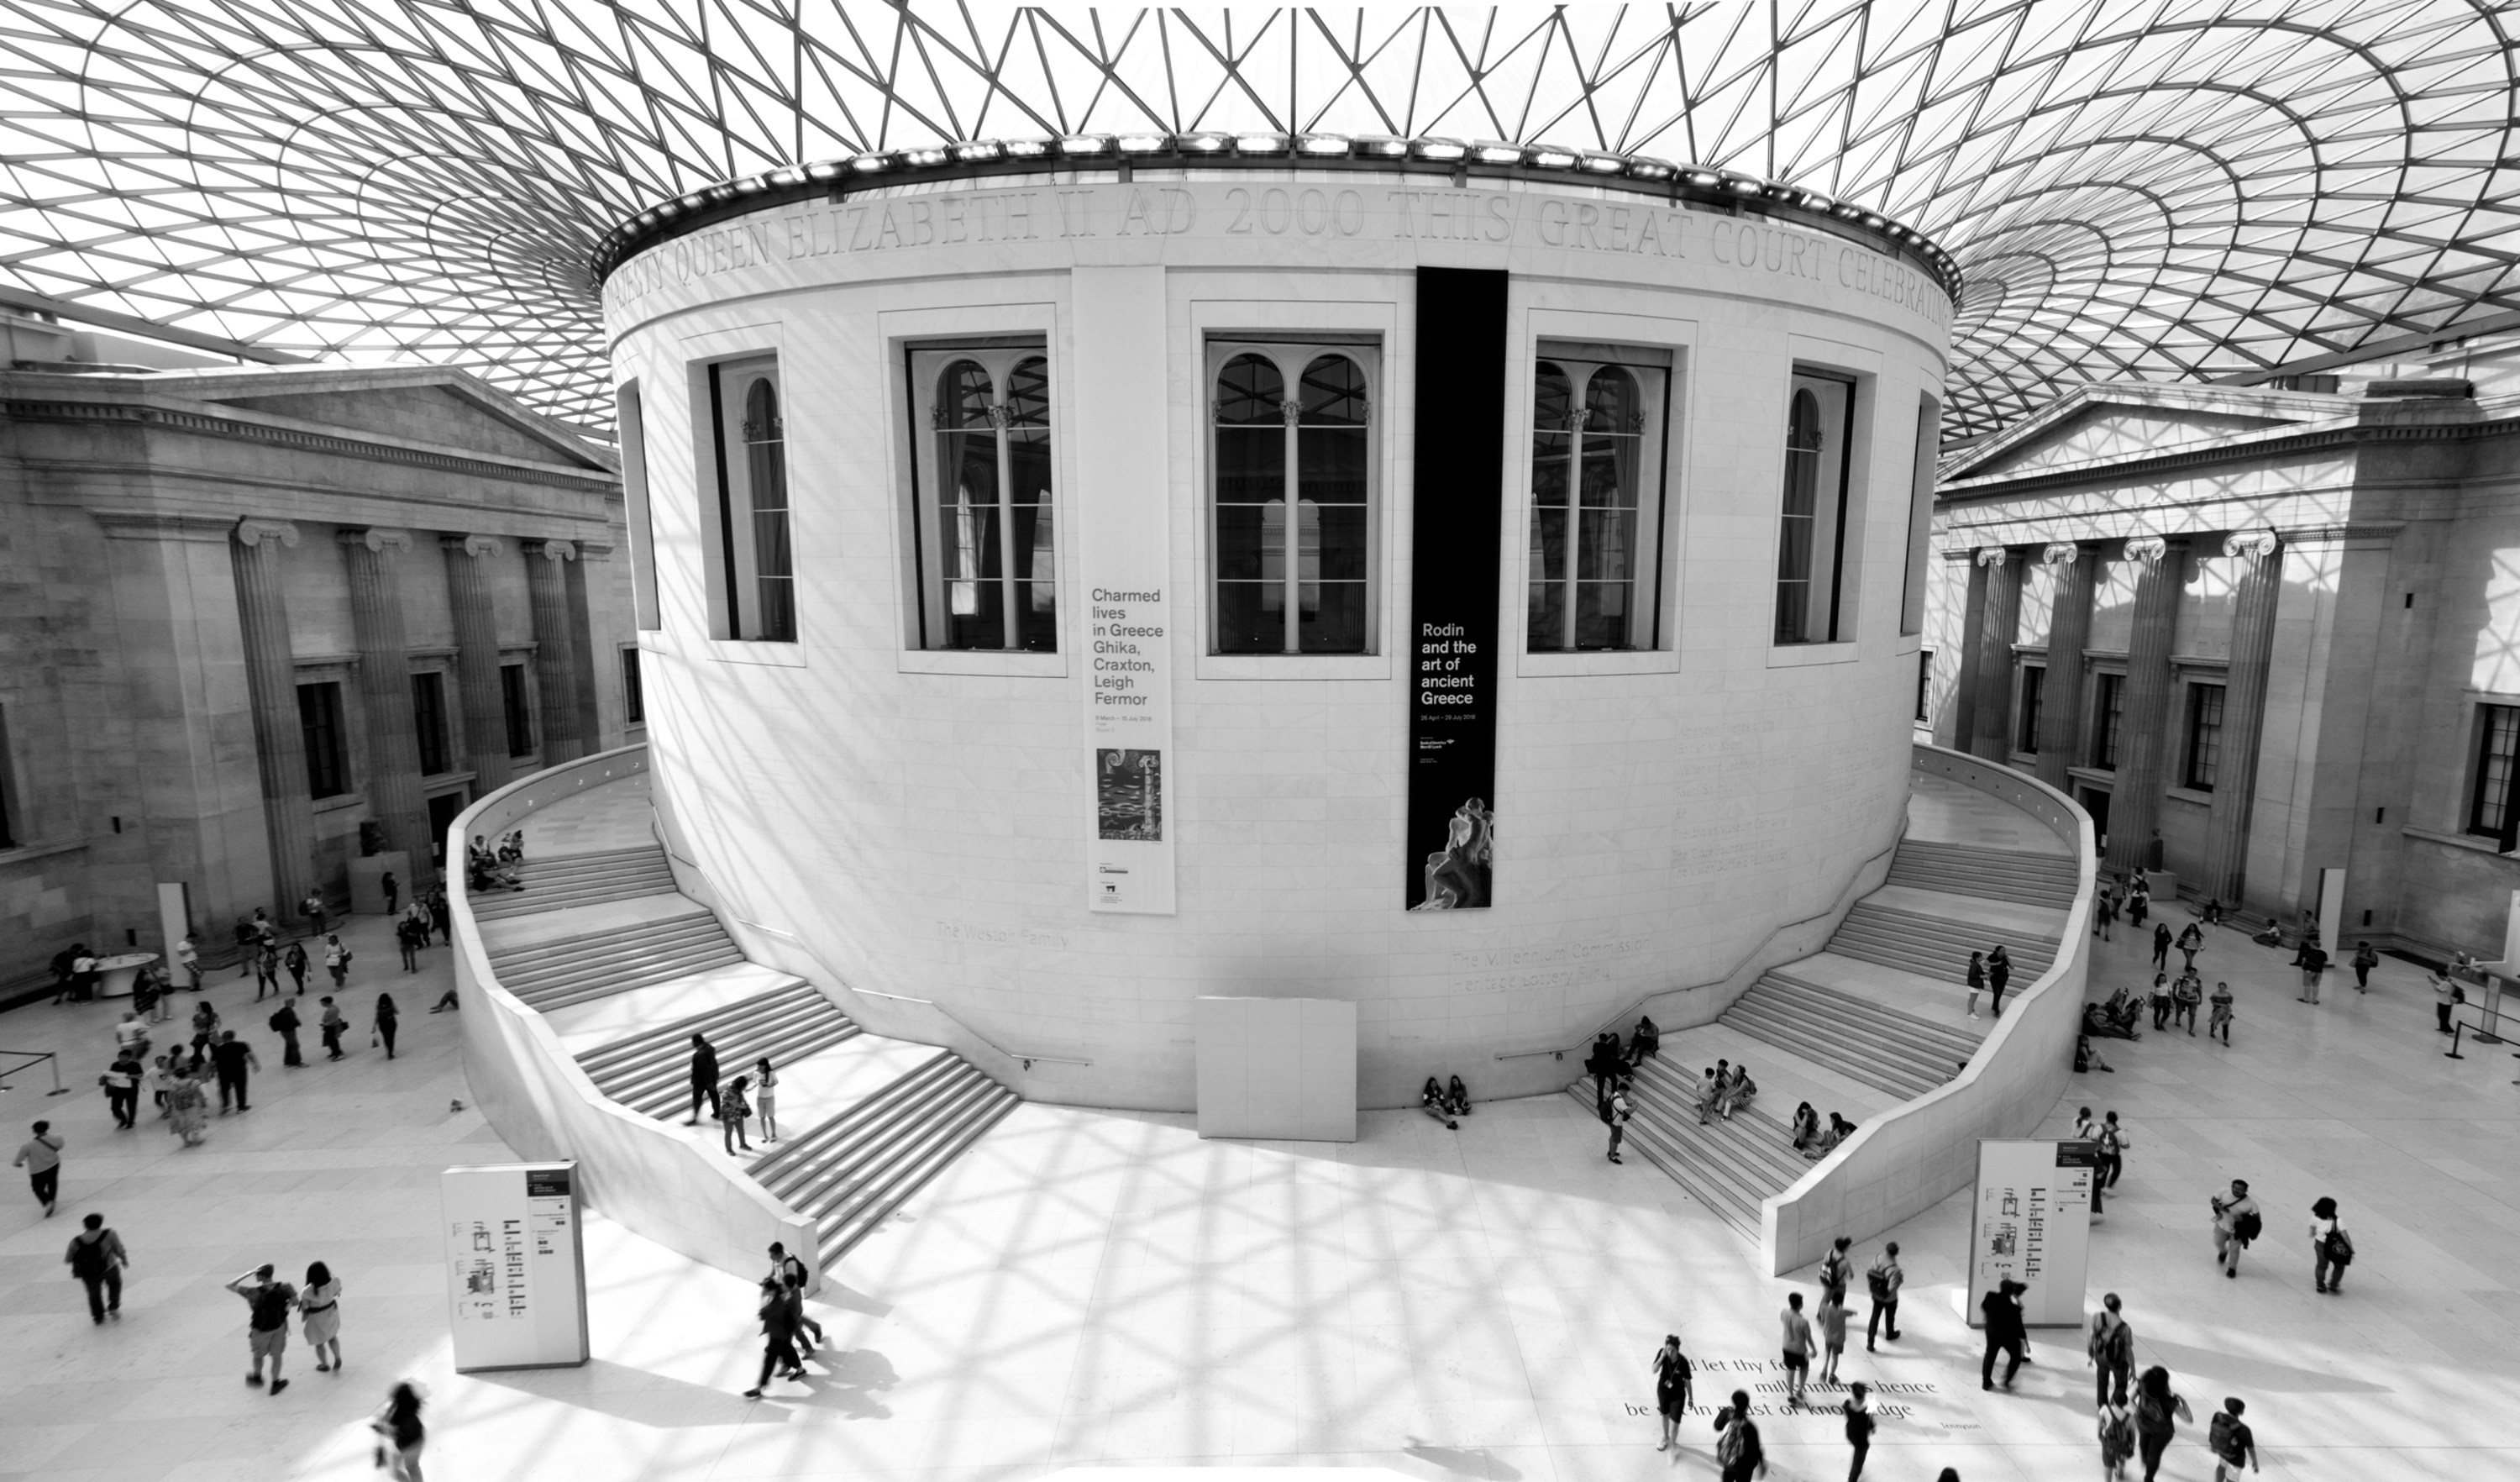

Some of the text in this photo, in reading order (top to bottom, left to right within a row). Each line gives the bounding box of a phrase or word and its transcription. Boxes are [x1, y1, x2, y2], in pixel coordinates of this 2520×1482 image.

[675, 221, 771, 286] QUEEN
[784, 192, 1039, 261] ELIZABETH
[1058, 190, 1095, 238] II
[1116, 187, 1197, 236] AD
[1226, 187, 1365, 237] 2000
[1388, 191, 1511, 243] THIS
[1536, 200, 1693, 259] GREAT
[1712, 219, 1827, 281] COURT
[1092, 587, 1161, 602] Charmed
[1093, 606, 1126, 619] lives
[1093, 623, 1163, 637] in Greece
[1422, 623, 1464, 637] Rodin
[1094, 640, 1141, 655] Ghika,
[1421, 640, 1477, 654] and the
[1094, 657, 1155, 673] Craxton,
[1421, 657, 1461, 670] art of
[1095, 675, 1134, 691] Leigh
[1421, 675, 1474, 688] ancient
[1095, 691, 1148, 706] Fermor
[1421, 691, 1473, 705] Greece
[936, 921, 1069, 950] The Weston Family
[1452, 952, 1479, 968] The
[1702, 1358, 1727, 1371] let
[1733, 1358, 1763, 1374] thy
[1874, 1380, 1939, 1393] hence
[1625, 1402, 1651, 1416] be
[1693, 1405, 1712, 1416] in
[1779, 1404, 1800, 1416] of
[1804, 1401, 1915, 1419] knodge
[1940, 1422, 1982, 1431] Tennyson
